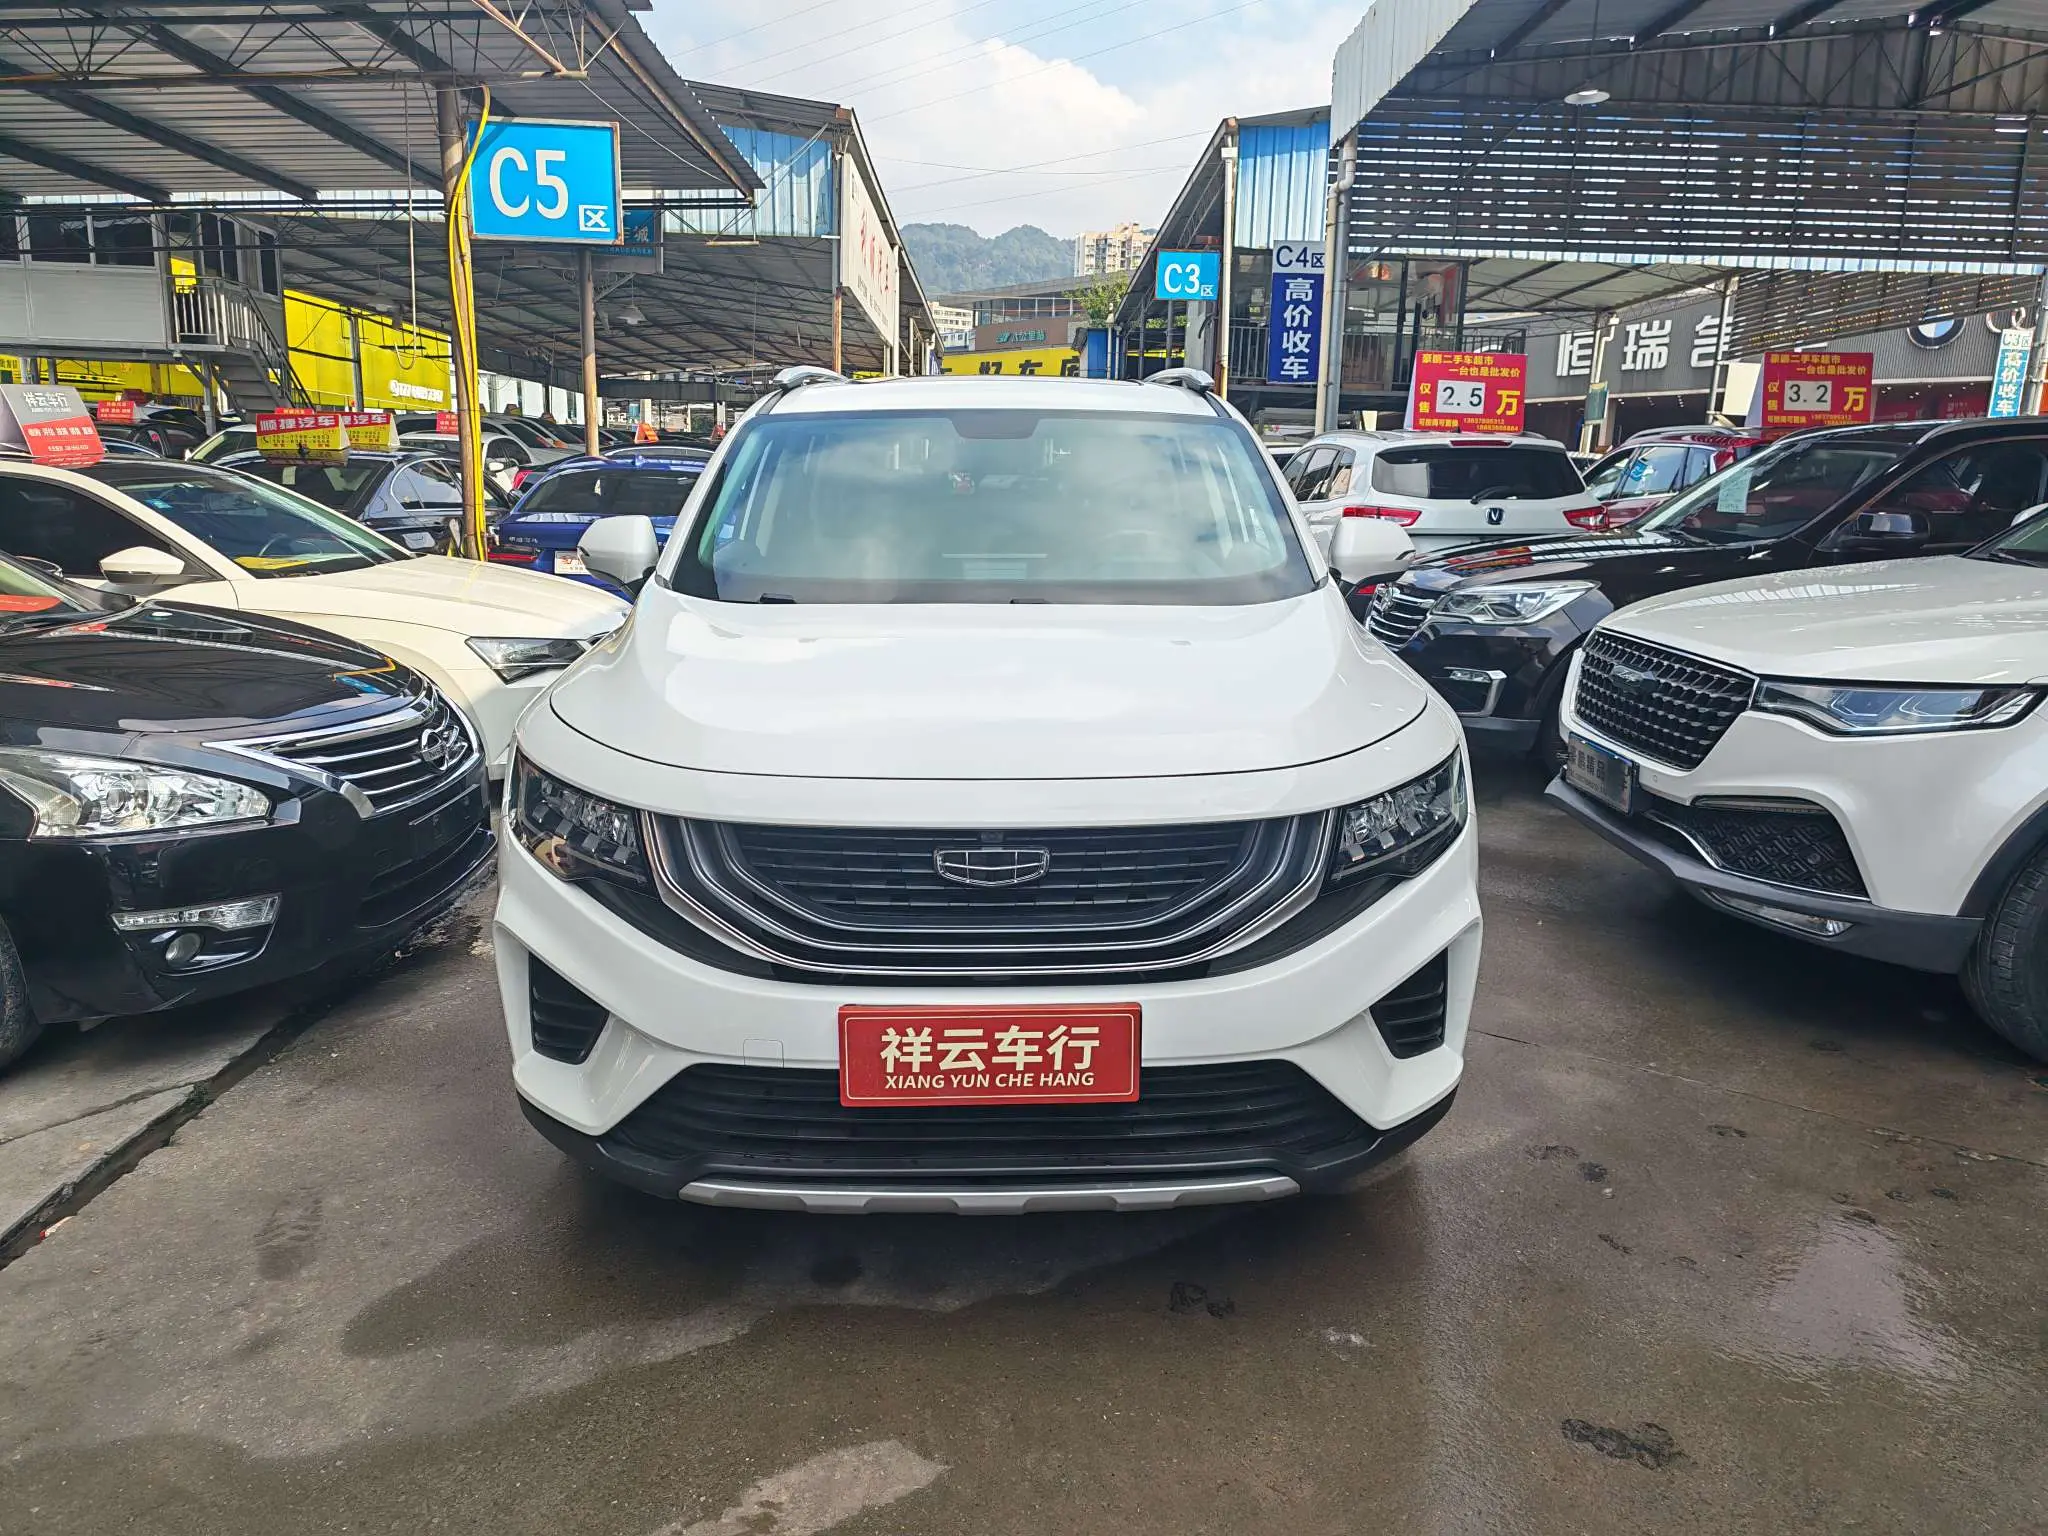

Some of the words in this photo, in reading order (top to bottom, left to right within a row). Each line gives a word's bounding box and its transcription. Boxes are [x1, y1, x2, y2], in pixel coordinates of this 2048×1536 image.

[489, 147, 611, 233] C5区
[1276, 245, 1325, 268] C4区
[1164, 263, 1214, 297] C3区
[1280, 277, 1315, 379] 高价收车
[1448, 366, 1521, 378] 一台也是批发价
[1995, 351, 2023, 416] 高价收车
[1442, 386, 1483, 407] 2.5
[1495, 389, 1521, 416] 万
[1788, 384, 1829, 403] 3.2
[1843, 386, 1867, 412] 万
[880, 1025, 1100, 1073] 祥云车行
[885, 1074, 945, 1089] XIANG
[951, 1074, 989, 1088] YUN
[995, 1073, 1034, 1088] CHE
[1039, 1072, 1095, 1087] HANG
